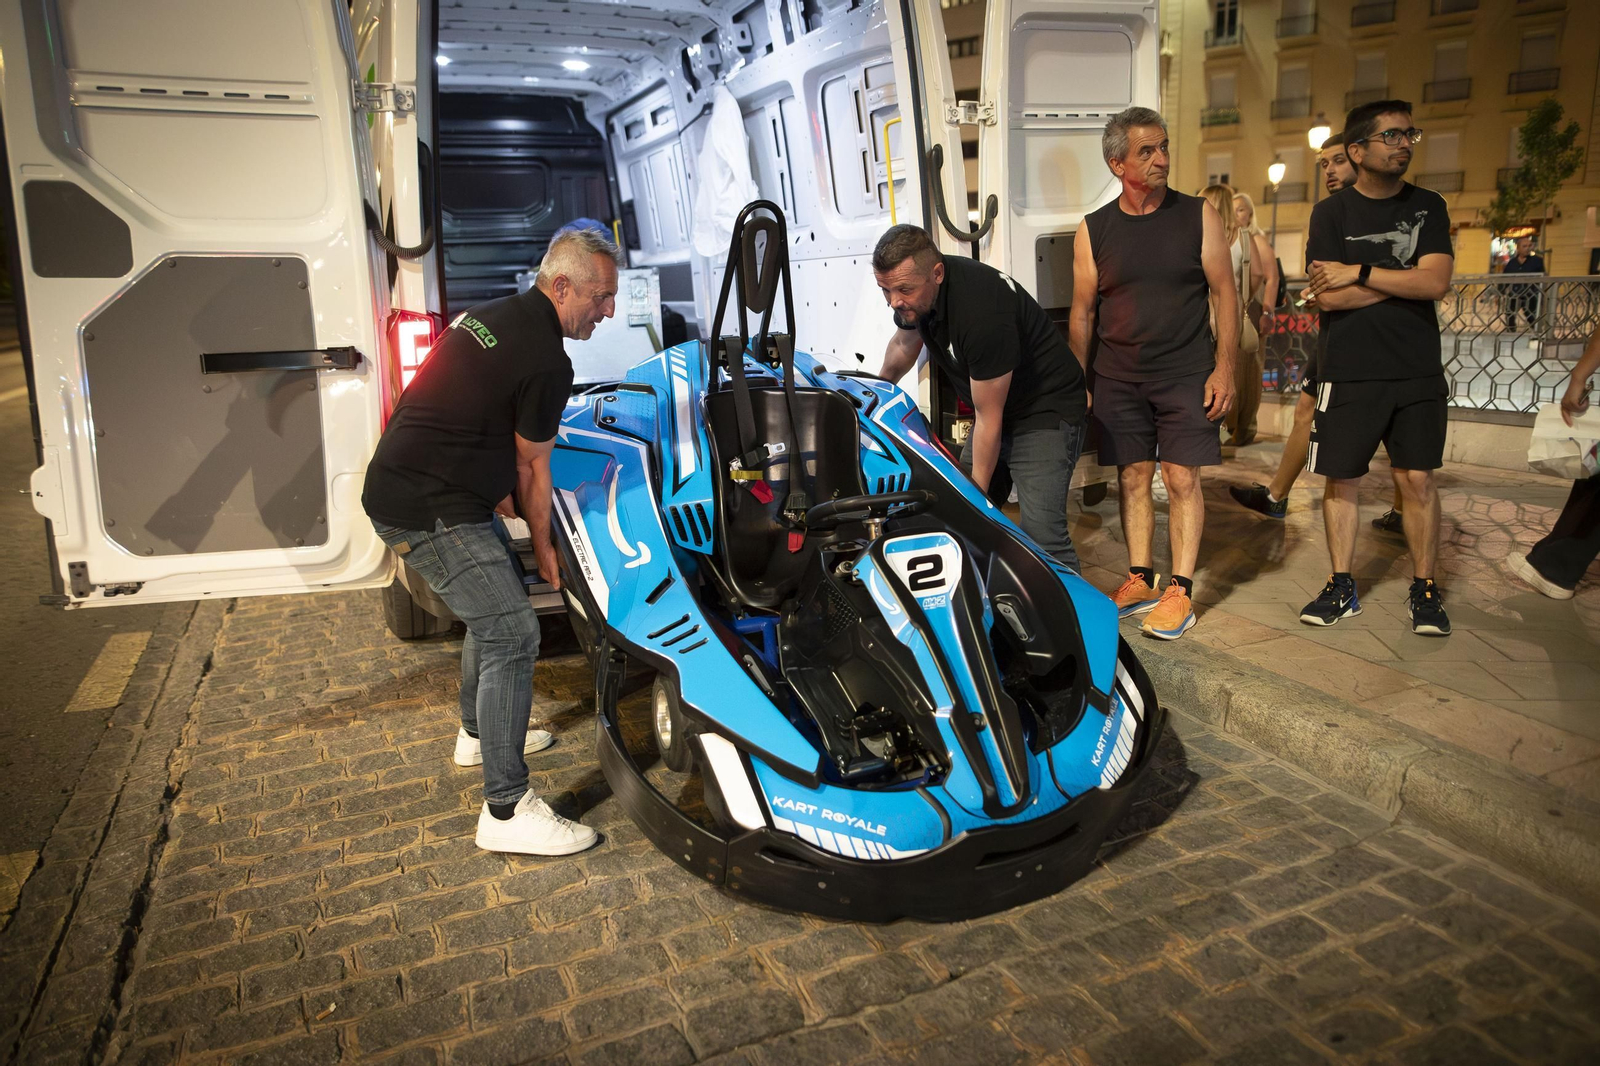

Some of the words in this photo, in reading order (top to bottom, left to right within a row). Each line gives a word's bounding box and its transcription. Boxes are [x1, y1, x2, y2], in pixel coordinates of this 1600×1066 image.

[572, 536, 588, 565] ELECTRIC
[907, 553, 946, 591] 2
[1091, 734, 1107, 767] KART
[1102, 698, 1119, 736] ROYALE
[772, 795, 818, 816] KART
[821, 808, 887, 837] ROYALE
